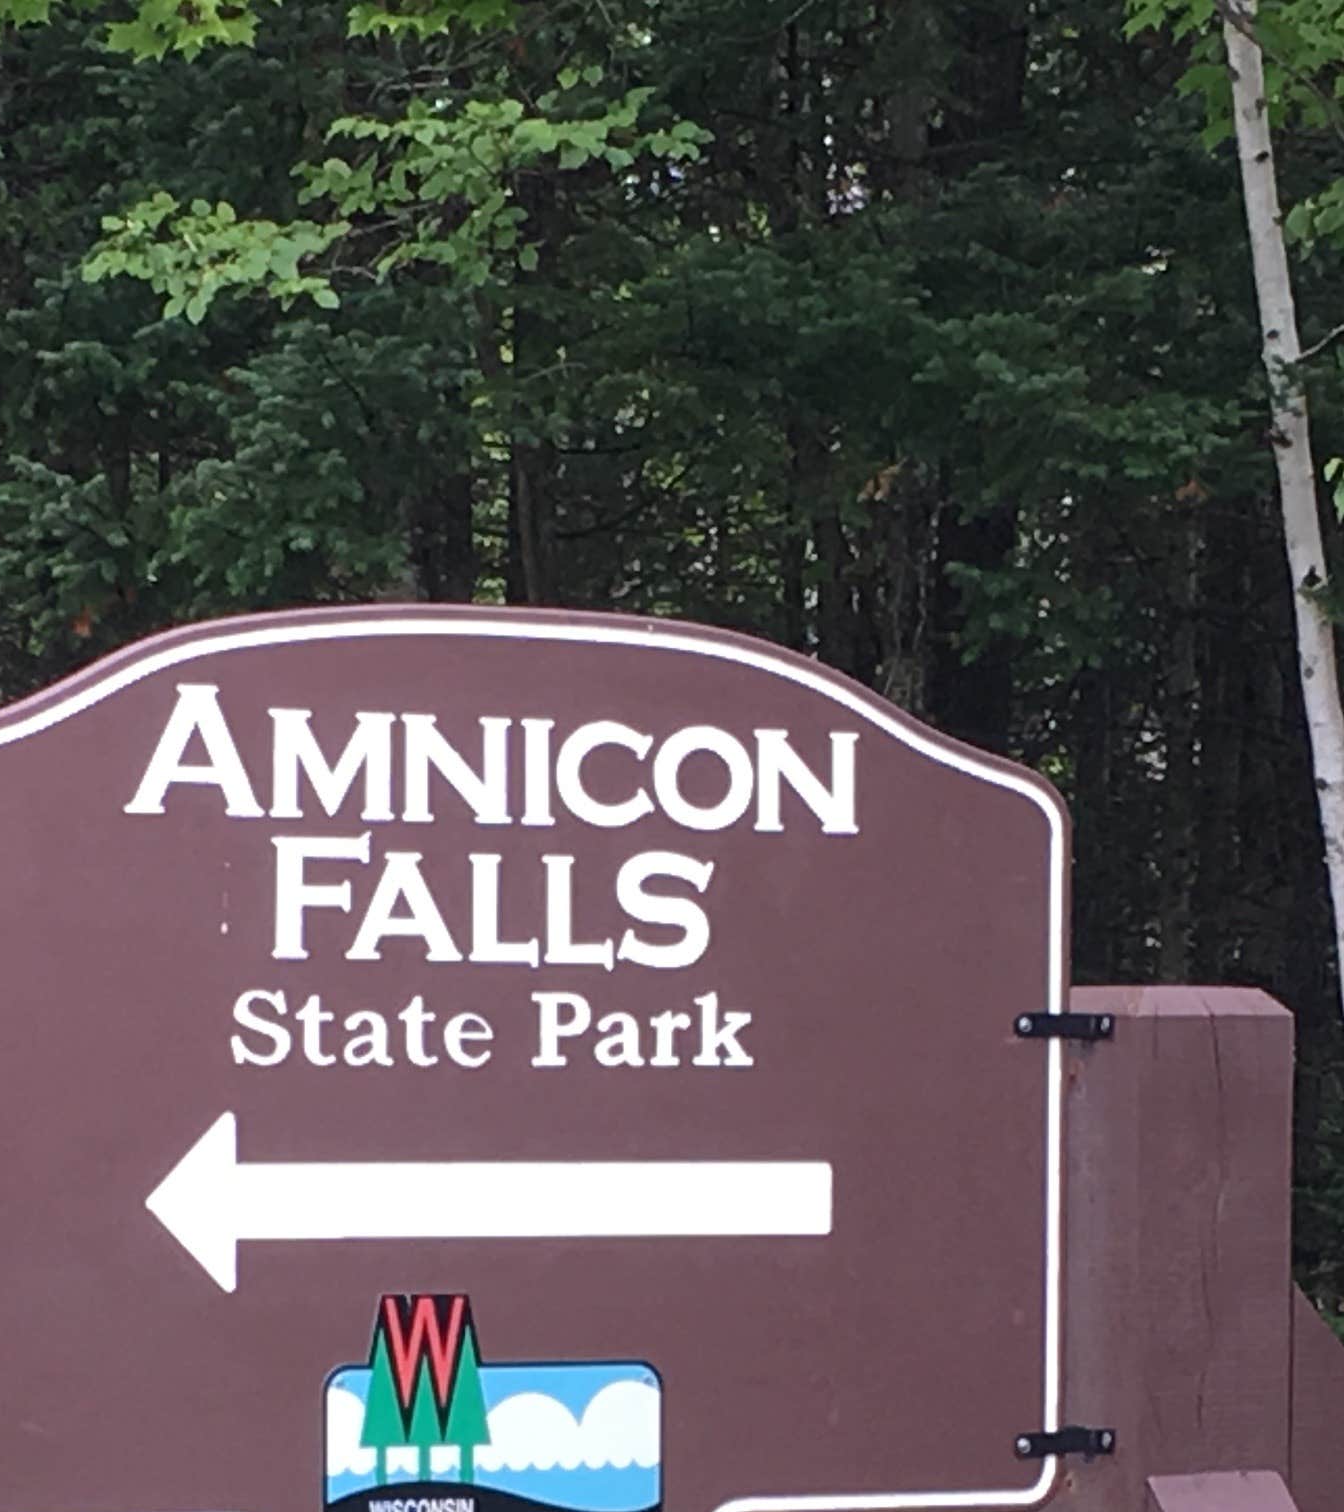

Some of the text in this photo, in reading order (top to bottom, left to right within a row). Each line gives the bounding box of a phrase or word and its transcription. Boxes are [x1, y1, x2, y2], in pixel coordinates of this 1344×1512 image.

[123, 681, 860, 834] AMNICON
[270, 829, 715, 969] FALLS
[230, 989, 754, 1068] State Park
